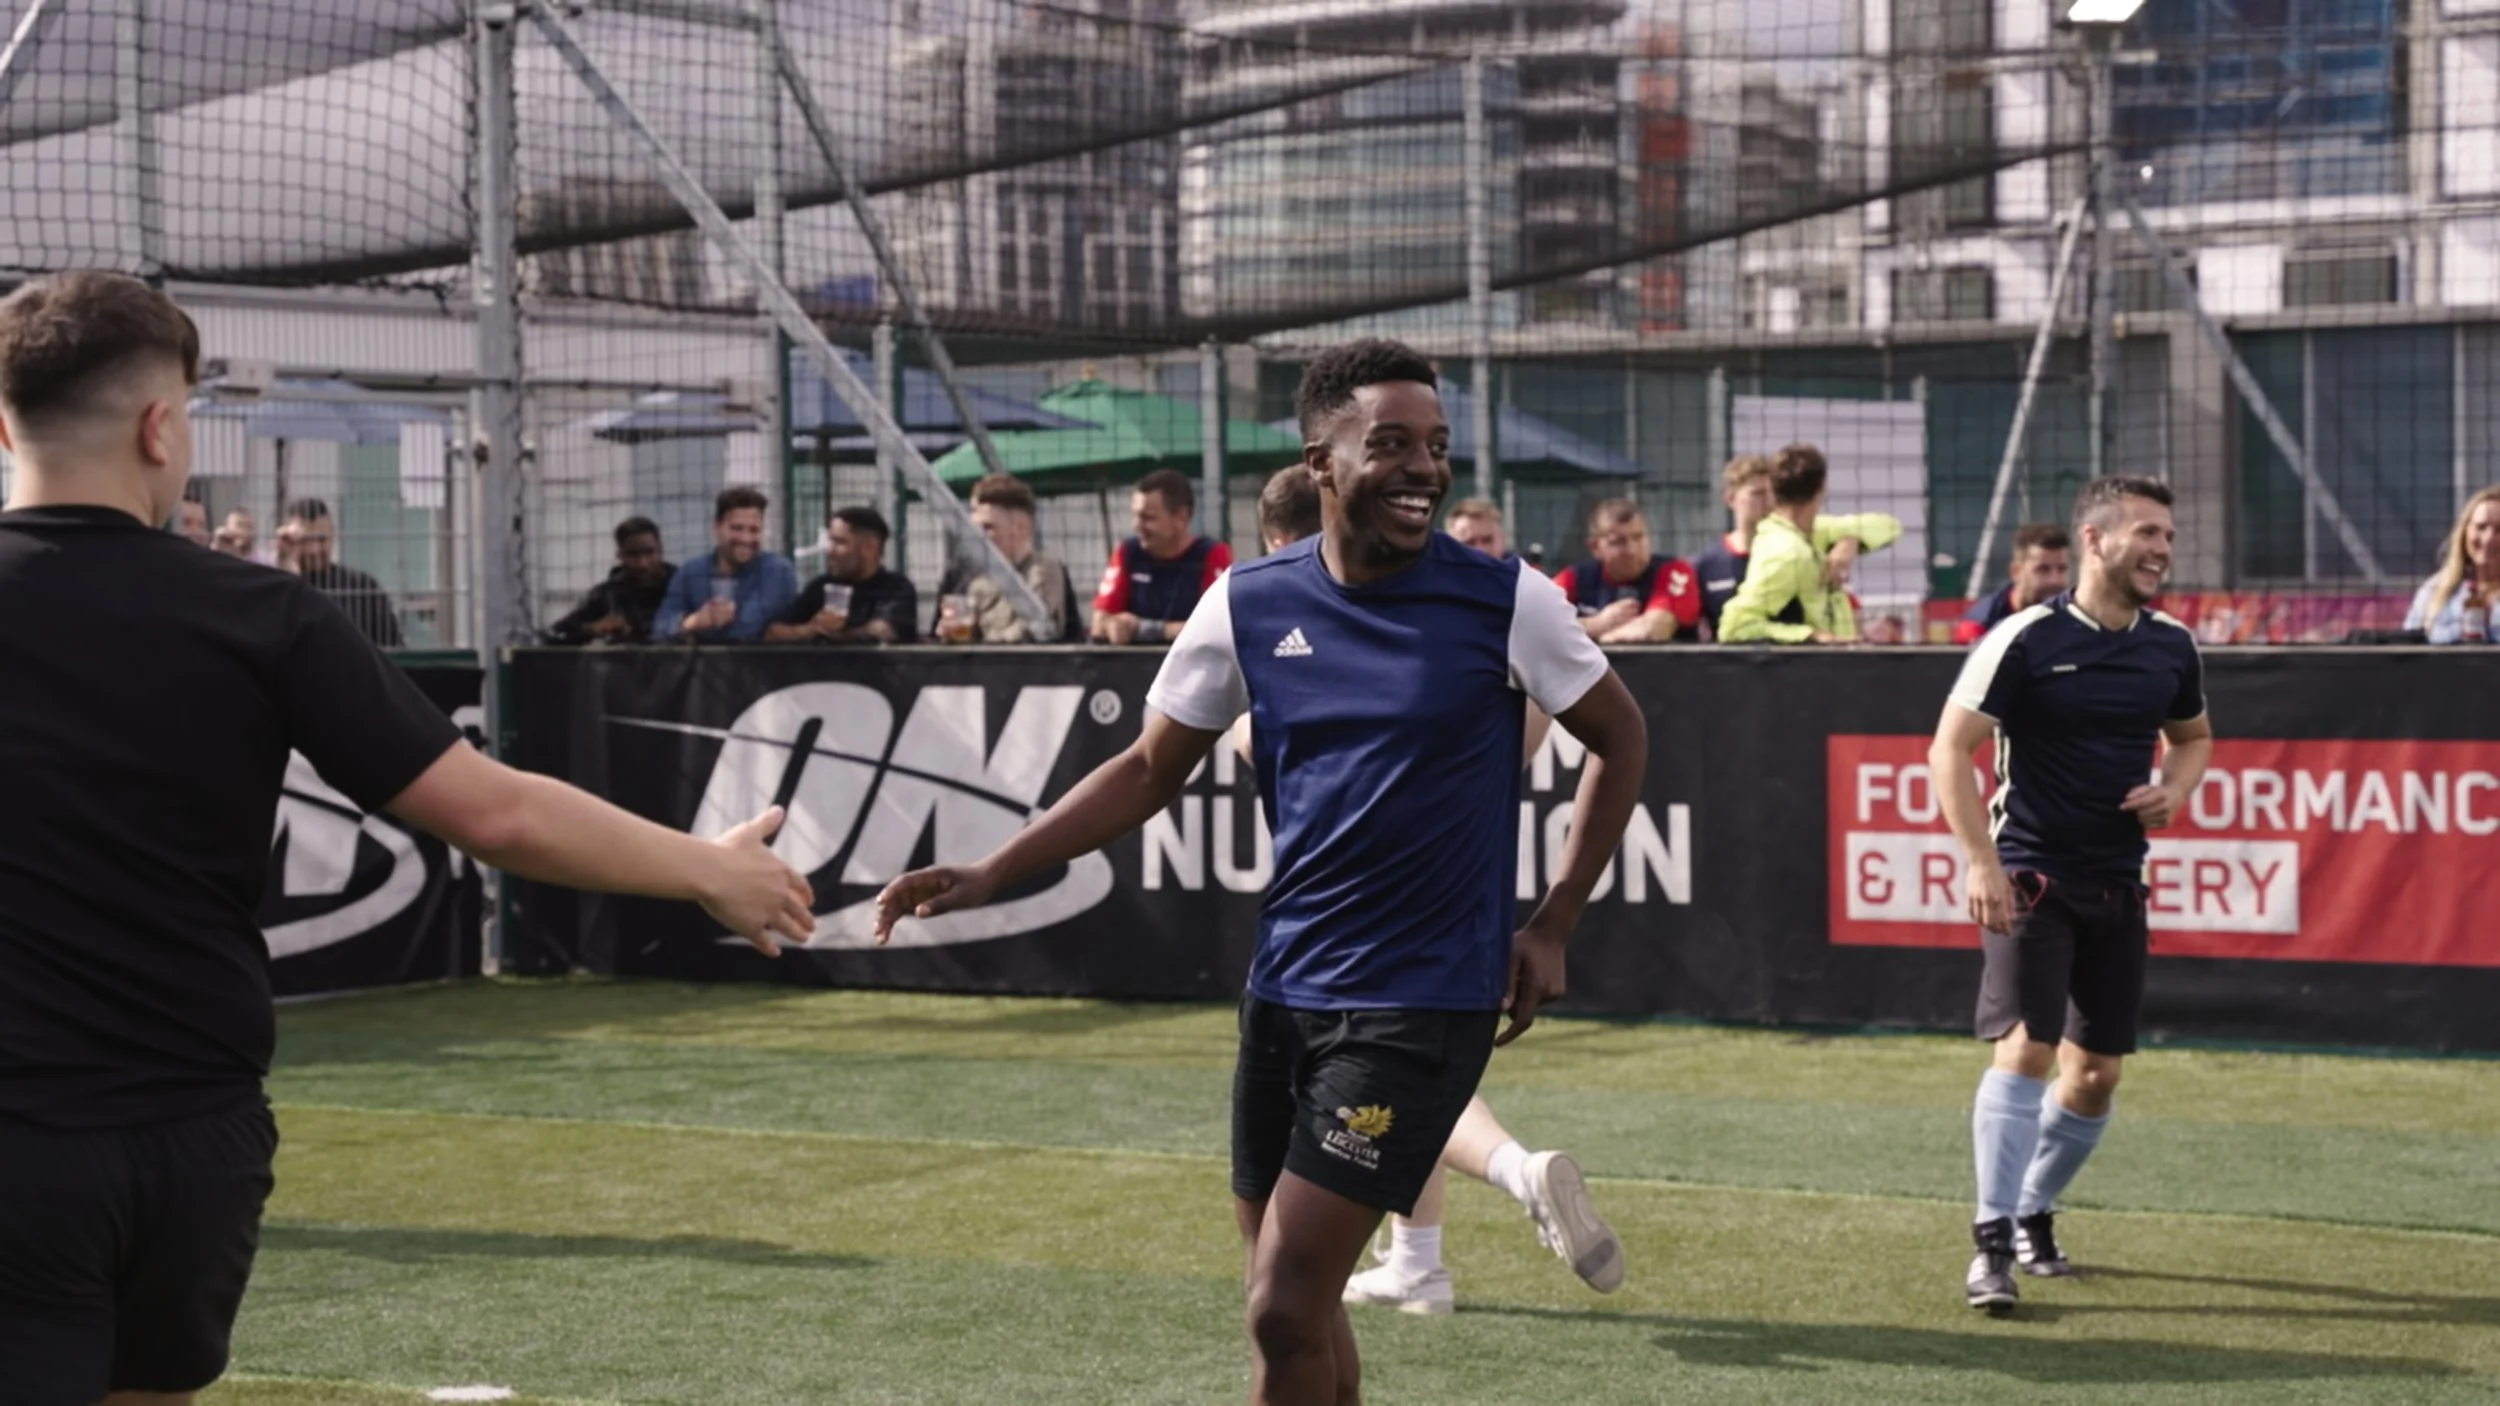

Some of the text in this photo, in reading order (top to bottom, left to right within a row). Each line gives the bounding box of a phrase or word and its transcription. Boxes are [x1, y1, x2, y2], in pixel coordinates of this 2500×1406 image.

[1274, 644, 1313, 657] adidas
[1857, 763, 1987, 825] FO
[1858, 851, 2282, 917] & RERY
